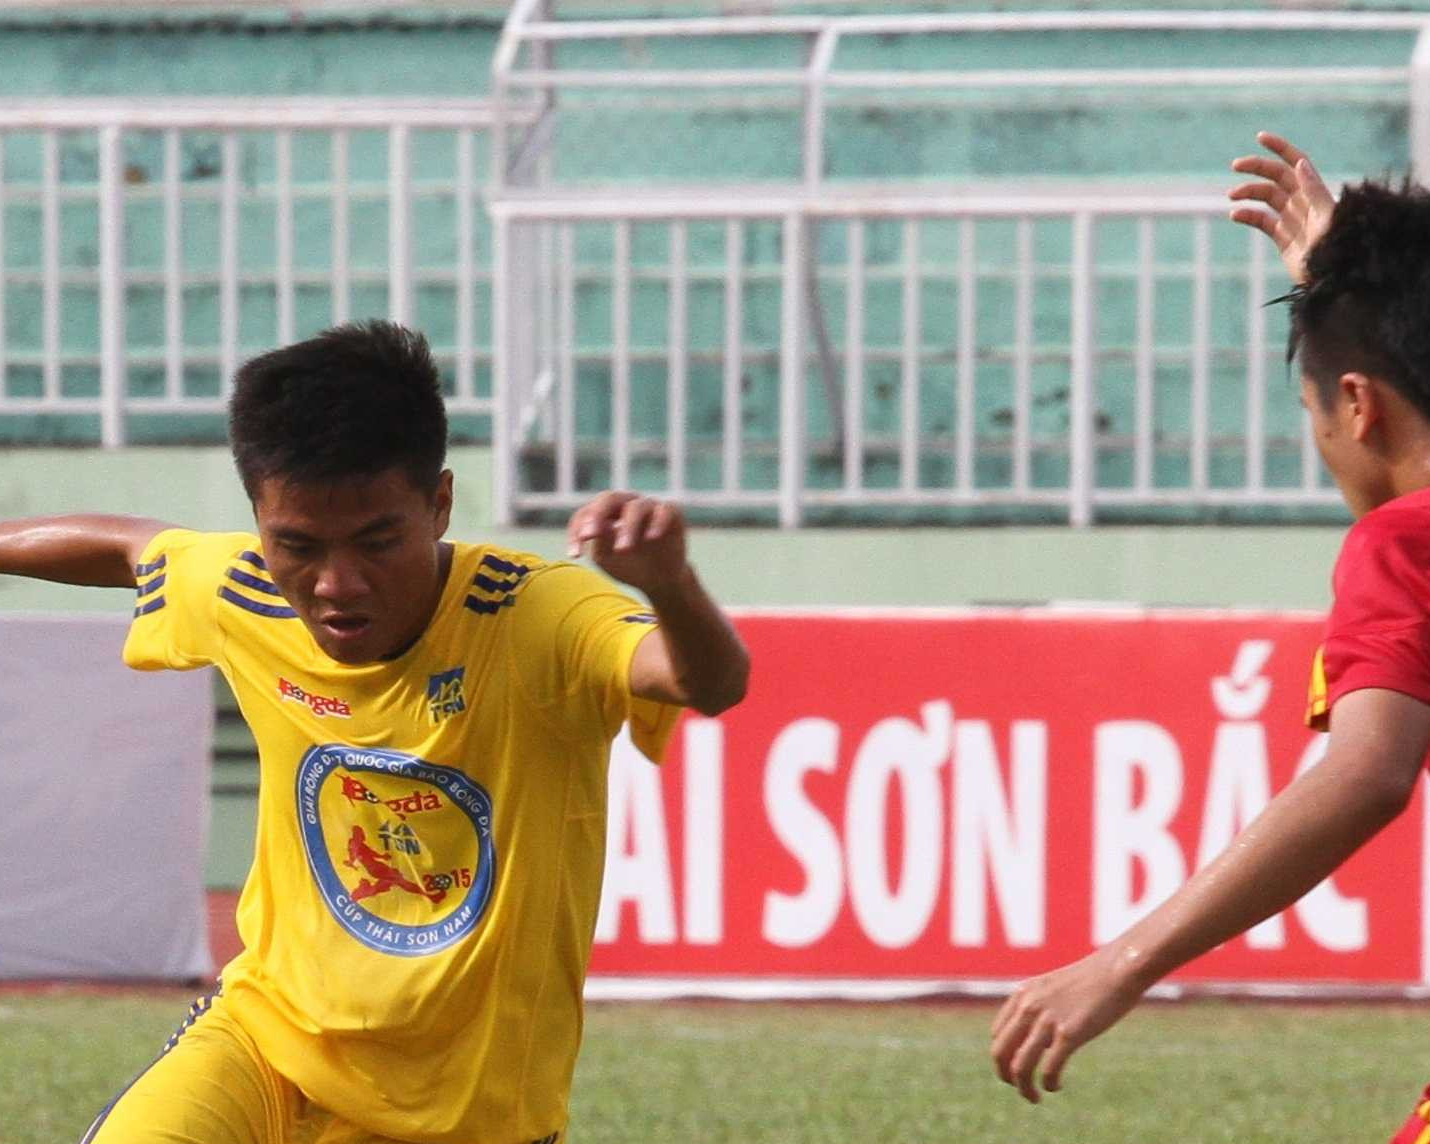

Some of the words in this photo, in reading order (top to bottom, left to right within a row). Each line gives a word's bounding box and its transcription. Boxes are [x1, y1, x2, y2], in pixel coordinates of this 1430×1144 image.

[760, 699, 1049, 949] SƠN
[335, 894, 364, 923] CÚP
[365, 920, 401, 945] THÁI
[443, 905, 473, 936] NAM
